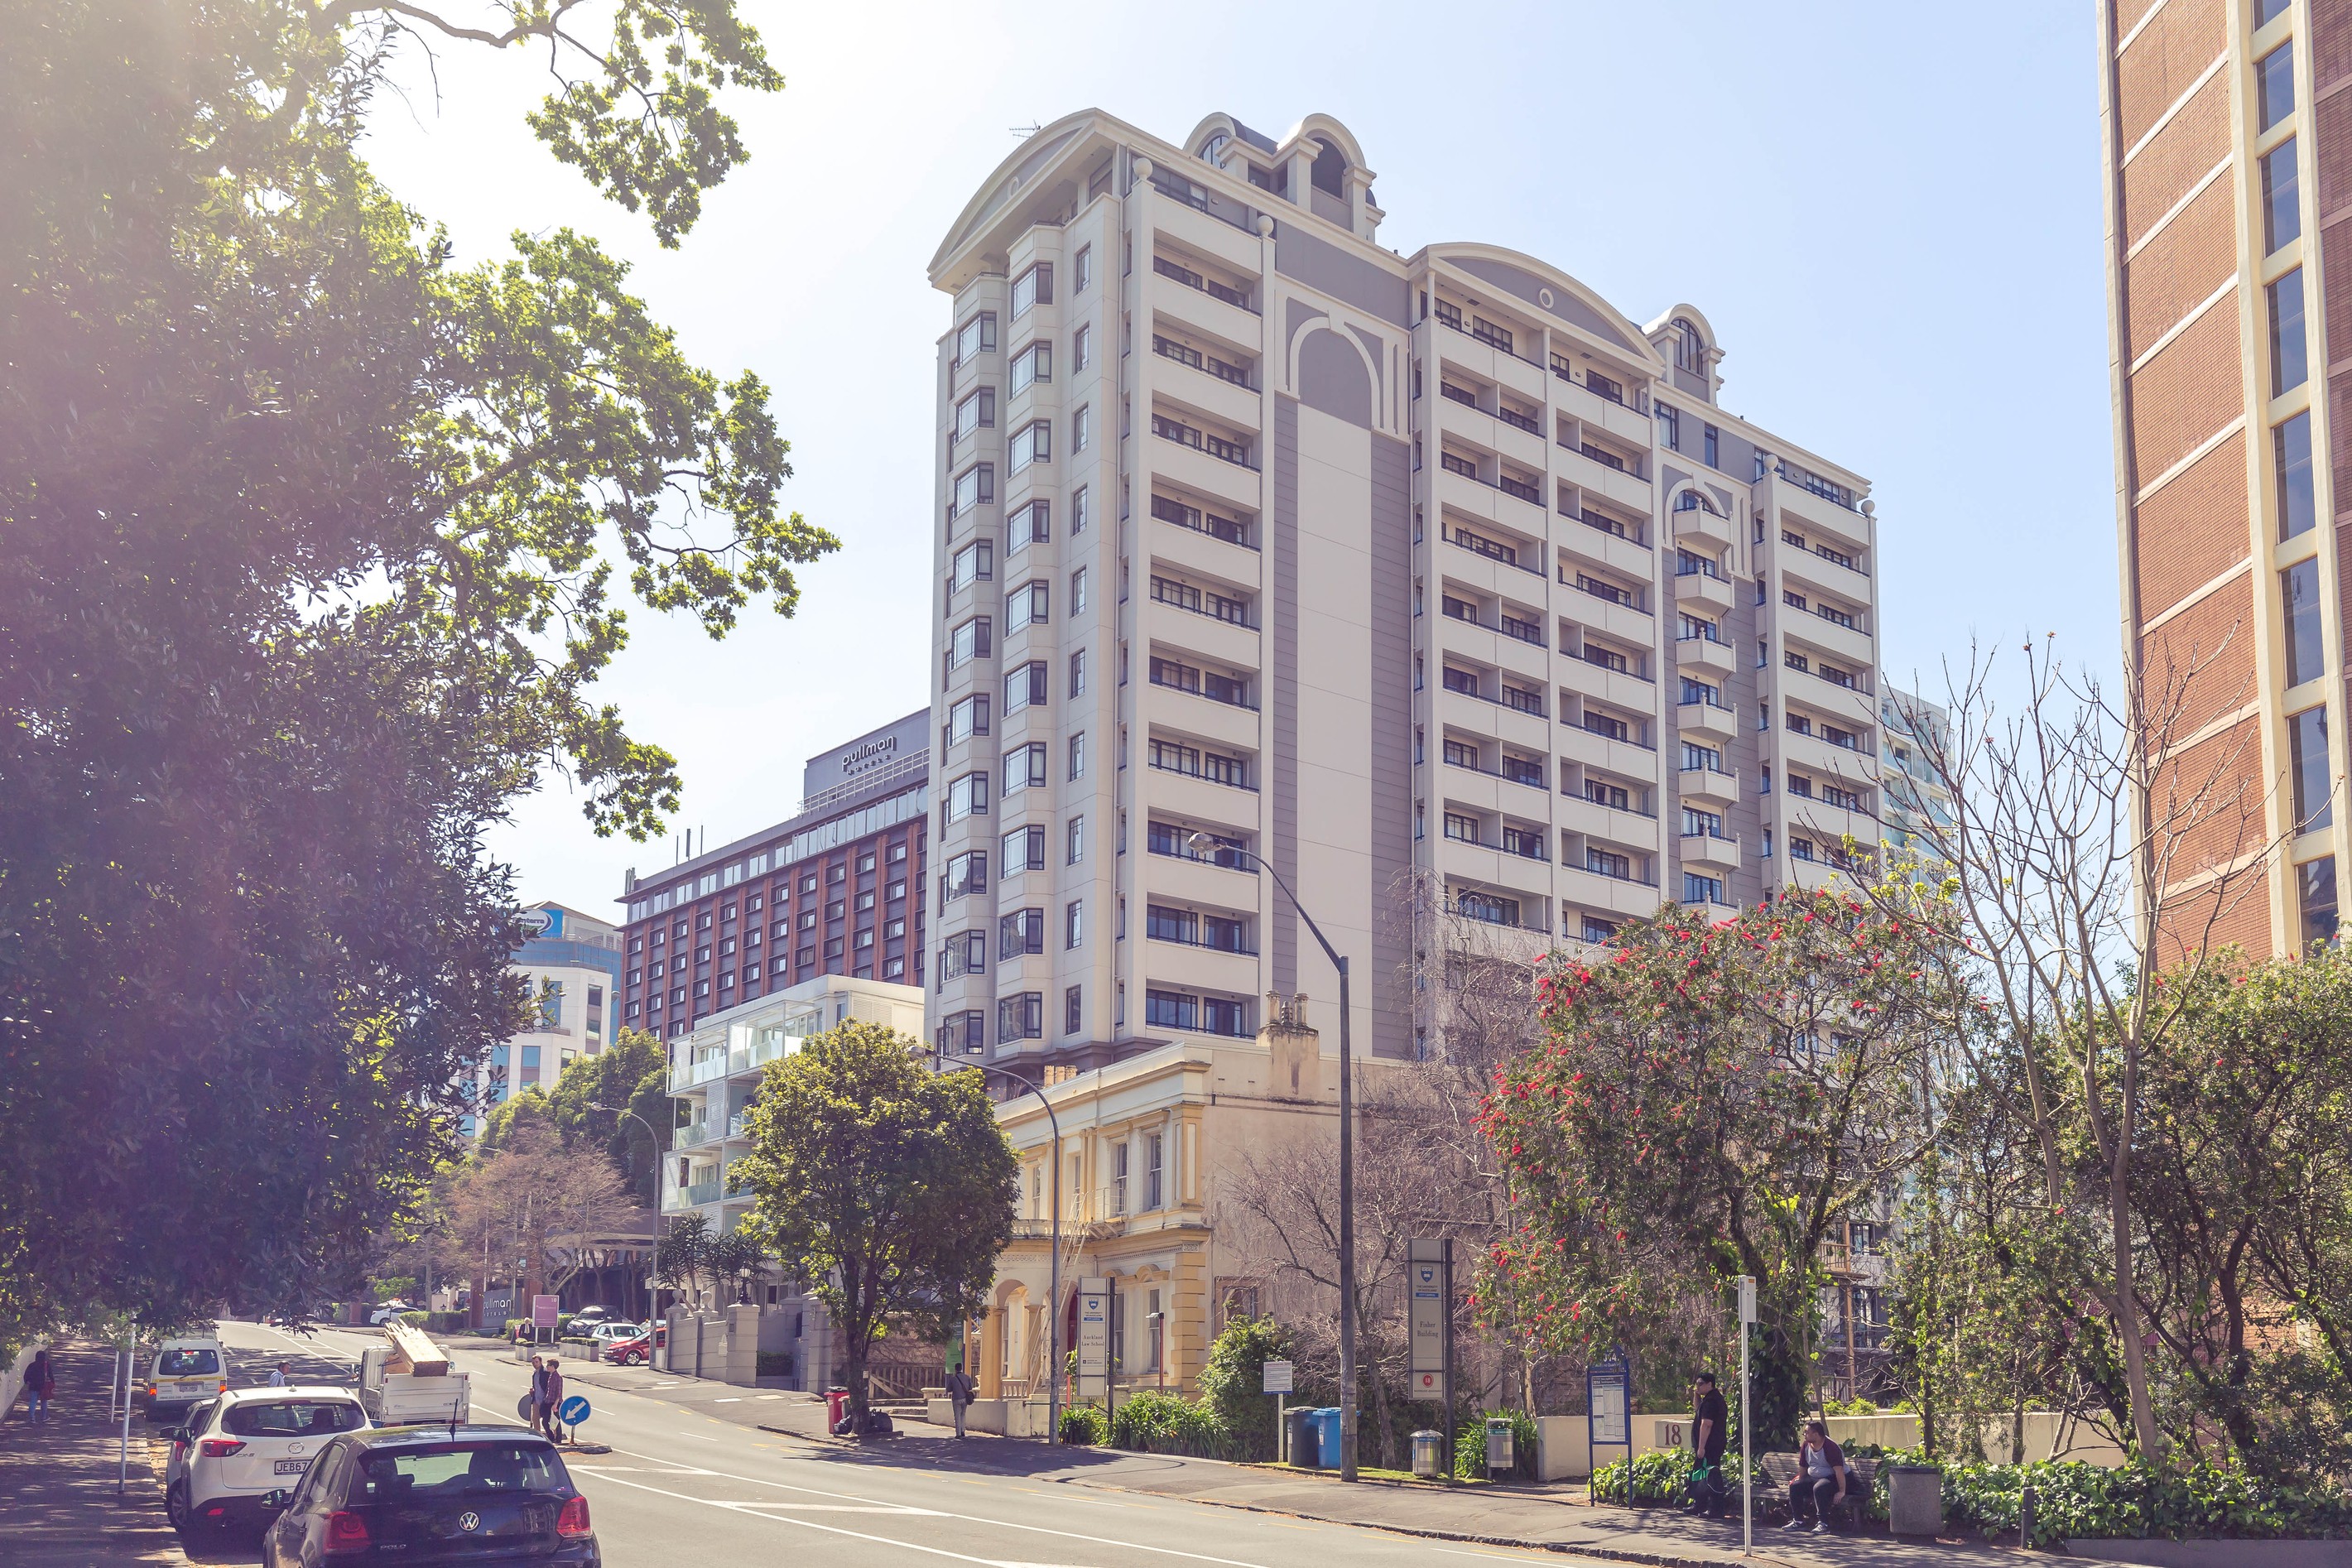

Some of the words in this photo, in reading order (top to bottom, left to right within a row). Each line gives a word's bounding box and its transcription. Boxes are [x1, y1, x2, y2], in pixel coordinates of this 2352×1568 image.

[841, 735, 895, 772] pullman
[1416, 1330, 1439, 1338] Building
[1665, 1424, 1682, 1445] 18
[277, 1462, 308, 1472] JEB67
